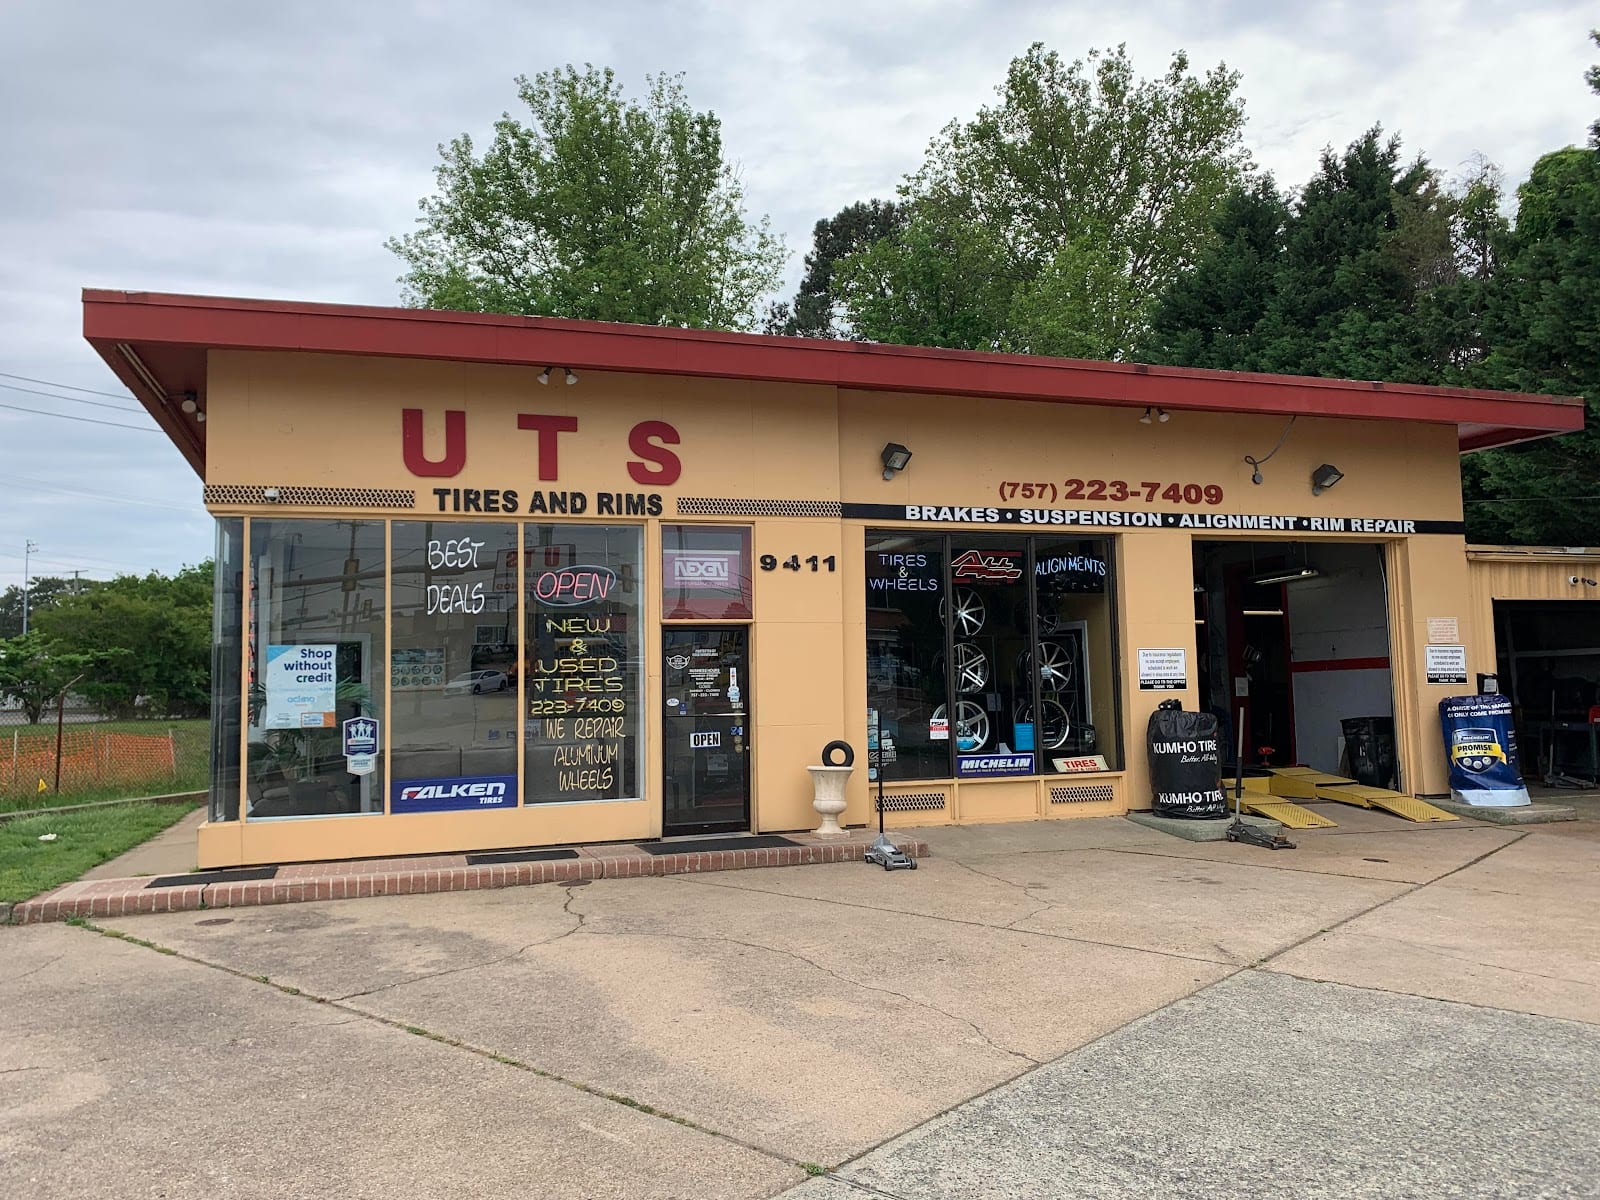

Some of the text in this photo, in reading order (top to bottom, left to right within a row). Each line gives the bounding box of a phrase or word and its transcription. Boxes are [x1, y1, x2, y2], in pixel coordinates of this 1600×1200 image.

[999, 478, 1224, 505] (757) 223-7409
[433, 488, 663, 517] TIRES AND RIMS
[905, 505, 1416, 534] BRAKES SUSPENSION ALIGNMENT RIM REPAIR
[428, 537, 486, 570] BEST
[878, 554, 927, 567] TIRES
[760, 554, 836, 572] 9411
[1035, 556, 1106, 576] ALIGNMENTS
[899, 566, 909, 578] &
[536, 572, 610, 598] OPEN
[869, 578, 938, 591] WHEELS
[427, 582, 485, 615] DEALS
[546, 618, 611, 633] NEW
[569, 638, 588, 654] &
[300, 648, 333, 660] Shop
[284, 661, 333, 671] without
[537, 657, 618, 673] USED
[296, 672, 333, 683] credit
[532, 676, 624, 693] TIRES
[531, 699, 625, 714] 223-7409
[546, 718, 565, 739] WE
[693, 733, 719, 746] OPEN
[1153, 740, 1217, 754] KUMHO TIRE
[1457, 744, 1493, 752] PROMISE
[960, 758, 1031, 769] MICHELIN
[1063, 759, 1097, 769] TIRES
[559, 768, 613, 791] WHEELS
[400, 782, 506, 800] FALKEN
[1158, 790, 1224, 804] KUMHO TIR
[479, 796, 503, 804] TIRES
